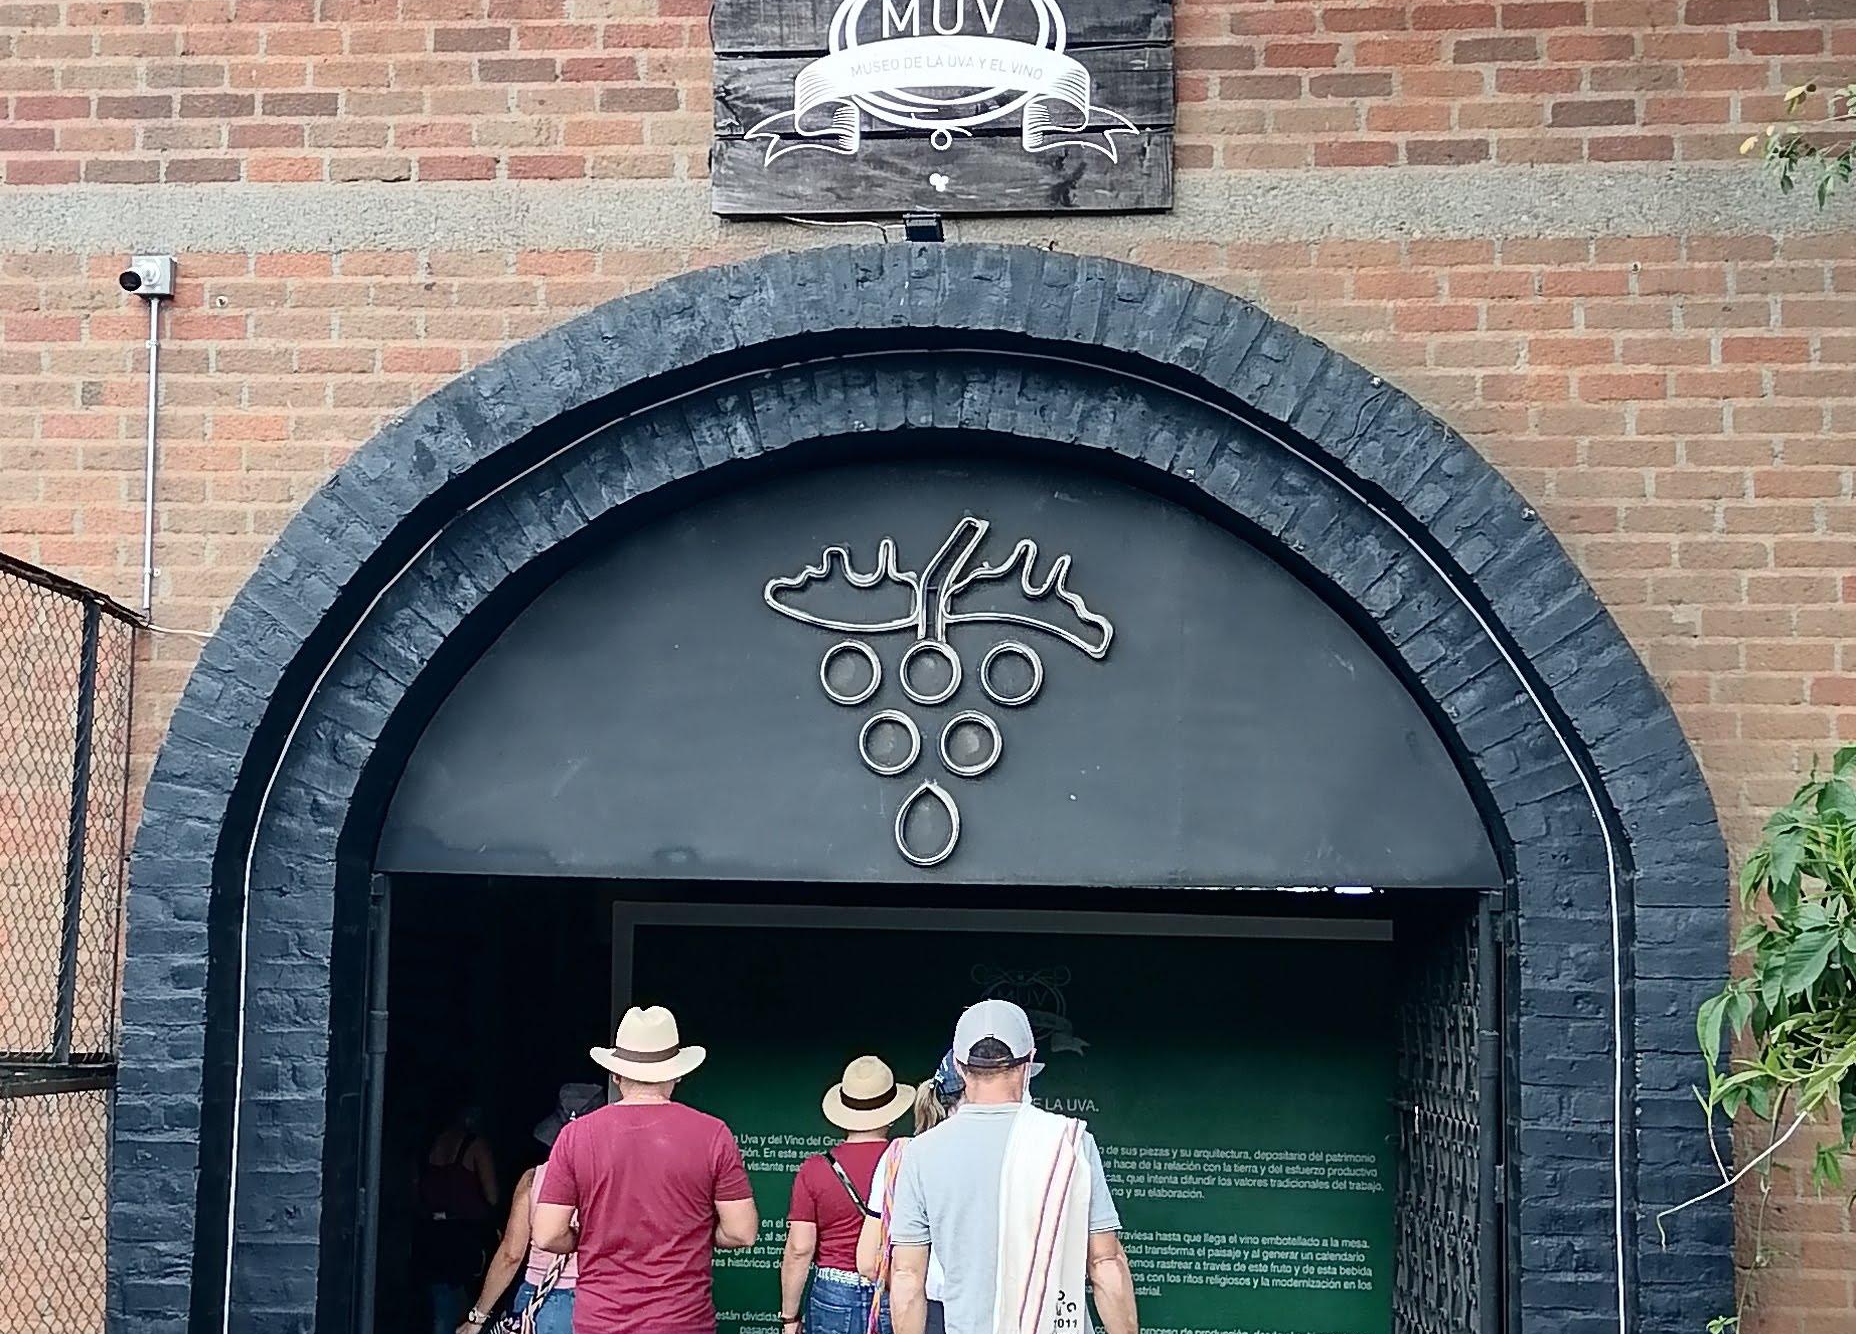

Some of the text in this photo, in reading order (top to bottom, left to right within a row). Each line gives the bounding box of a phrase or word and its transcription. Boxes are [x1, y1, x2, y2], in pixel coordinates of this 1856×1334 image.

[850, 55, 1043, 81] MUSEO DE LA UVA Y EL VINO
[1045, 1098, 1063, 1111] LA
[1067, 1099, 1100, 1112] UVA.
[740, 1134, 758, 1145] Uva
[760, 1137, 766, 1147] y
[768, 1135, 782, 1145] del
[784, 1135, 804, 1145] Vino
[806, 1136, 821, 1146] del
[1106, 1146, 1118, 1155] de
[1121, 1147, 1137, 1156] sus
[1140, 1147, 1170, 1158] piezas
[1172, 1148, 1178, 1159] y
[1180, 1148, 1191, 1157] su
[1308, 1151, 1323, 1161] del
[1325, 1153, 1376, 1164] patrimonio
[764, 1148, 775, 1158] En
[778, 1148, 797, 1158] este
[1114, 1159, 1136, 1169] hace
[1138, 1160, 1151, 1169] de
[1153, 1160, 1161, 1170] la
[1203, 1163, 1220, 1172] con
[1223, 1162, 1232, 1172] la
[1234, 1163, 1258, 1173] tierra
[1260, 1165, 1266, 1176] y
[1268, 1164, 1283, 1174] del
[1285, 1165, 1325, 1175] esfuerzo
[747, 1161, 783, 1172] visitante
[1126, 1174, 1145, 1185] que
[1147, 1173, 1178, 1184] intenta
[1218, 1175, 1232, 1186] los
[1233, 1177, 1268, 1187] valores
[1270, 1178, 1330, 1189] tradicionales
[1331, 1179, 1346, 1190] del
[1126, 1188, 1132, 1198] y
[1134, 1188, 1146, 1197] su
[762, 1219, 773, 1228] en
[776, 1218, 784, 1228] el
[1119, 1230, 1153, 1241] traviesa
[1155, 1231, 1181, 1242] hasta
[1183, 1233, 1202, 1244] que
[1203, 1233, 1226, 1246] llega
[1229, 1233, 1237, 1243] el
[1239, 1234, 1259, 1245] vino
[1261, 1235, 1320, 1247] embotellado
[1322, 1238, 1328, 1247] a
[1330, 1237, 1339, 1247] la
[765, 1232, 773, 1241] al
[1145, 1245, 1195, 1255] transforma
[1197, 1245, 1206, 1257] el
[1207, 1247, 1241, 1260] paisaje
[1243, 1250, 1249, 1260] y
[1251, 1249, 1260, 1259] al
[1262, 1250, 1299, 1261] generar
[1301, 1252, 1313, 1260] un
[1315, 1251, 1365, 1262] calendario
[727, 1258, 770, 1268] históricos
[1146, 1274, 1165, 1283] con
[1167, 1272, 1181, 1283] los
[1183, 1273, 1203, 1284] ritos
[1253, 1277, 1259, 1288] y
[1261, 1276, 1269, 1287] la
[1343, 1280, 1356, 1289] en
[1358, 1279, 1372, 1290] los
[753, 1246, 765, 1255] en
[1194, 1261, 1201, 1270] a
[1233, 1261, 1246, 1272] de
[1248, 1262, 1268, 1273] este
[1270, 1261, 1292, 1273] fruto
[1294, 1265, 1300, 1276] y
[1302, 1264, 1314, 1274] de
[1317, 1265, 1337, 1275] esta
[1339, 1266, 1372, 1276] bebida
